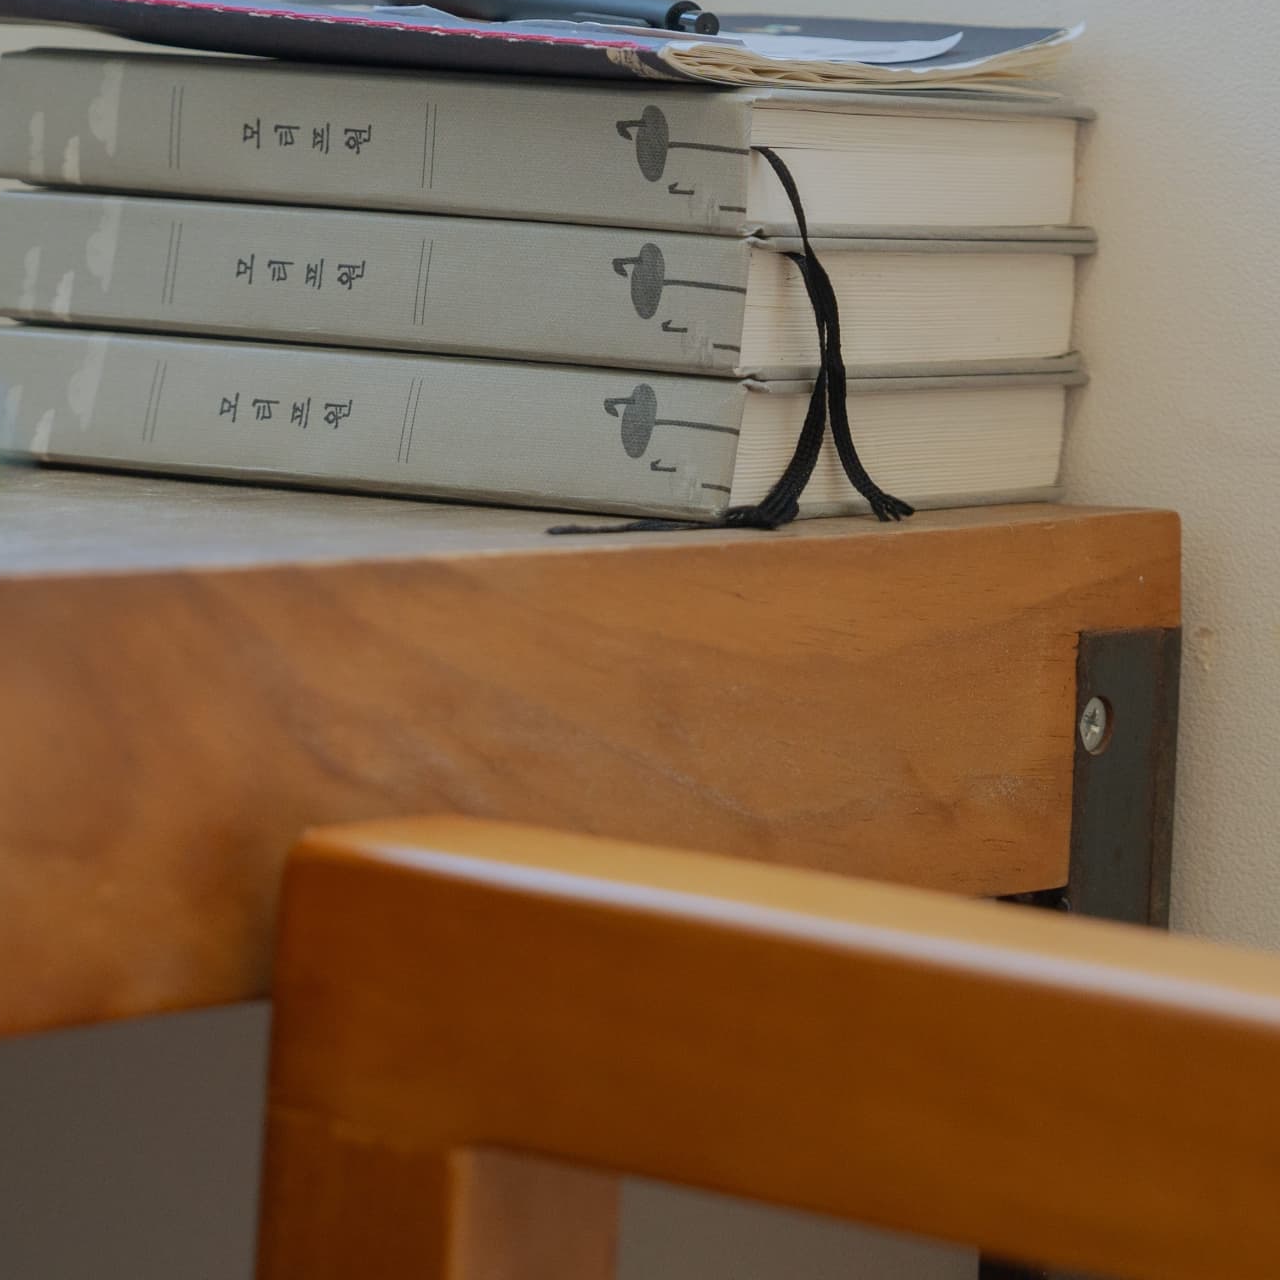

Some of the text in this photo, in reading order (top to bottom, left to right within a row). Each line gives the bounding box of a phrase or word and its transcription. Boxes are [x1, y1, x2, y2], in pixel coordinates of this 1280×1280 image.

[242, 117, 372, 154] 모티프원
[235, 253, 366, 290] 모티프원
[218, 392, 353, 429] 모티프원
